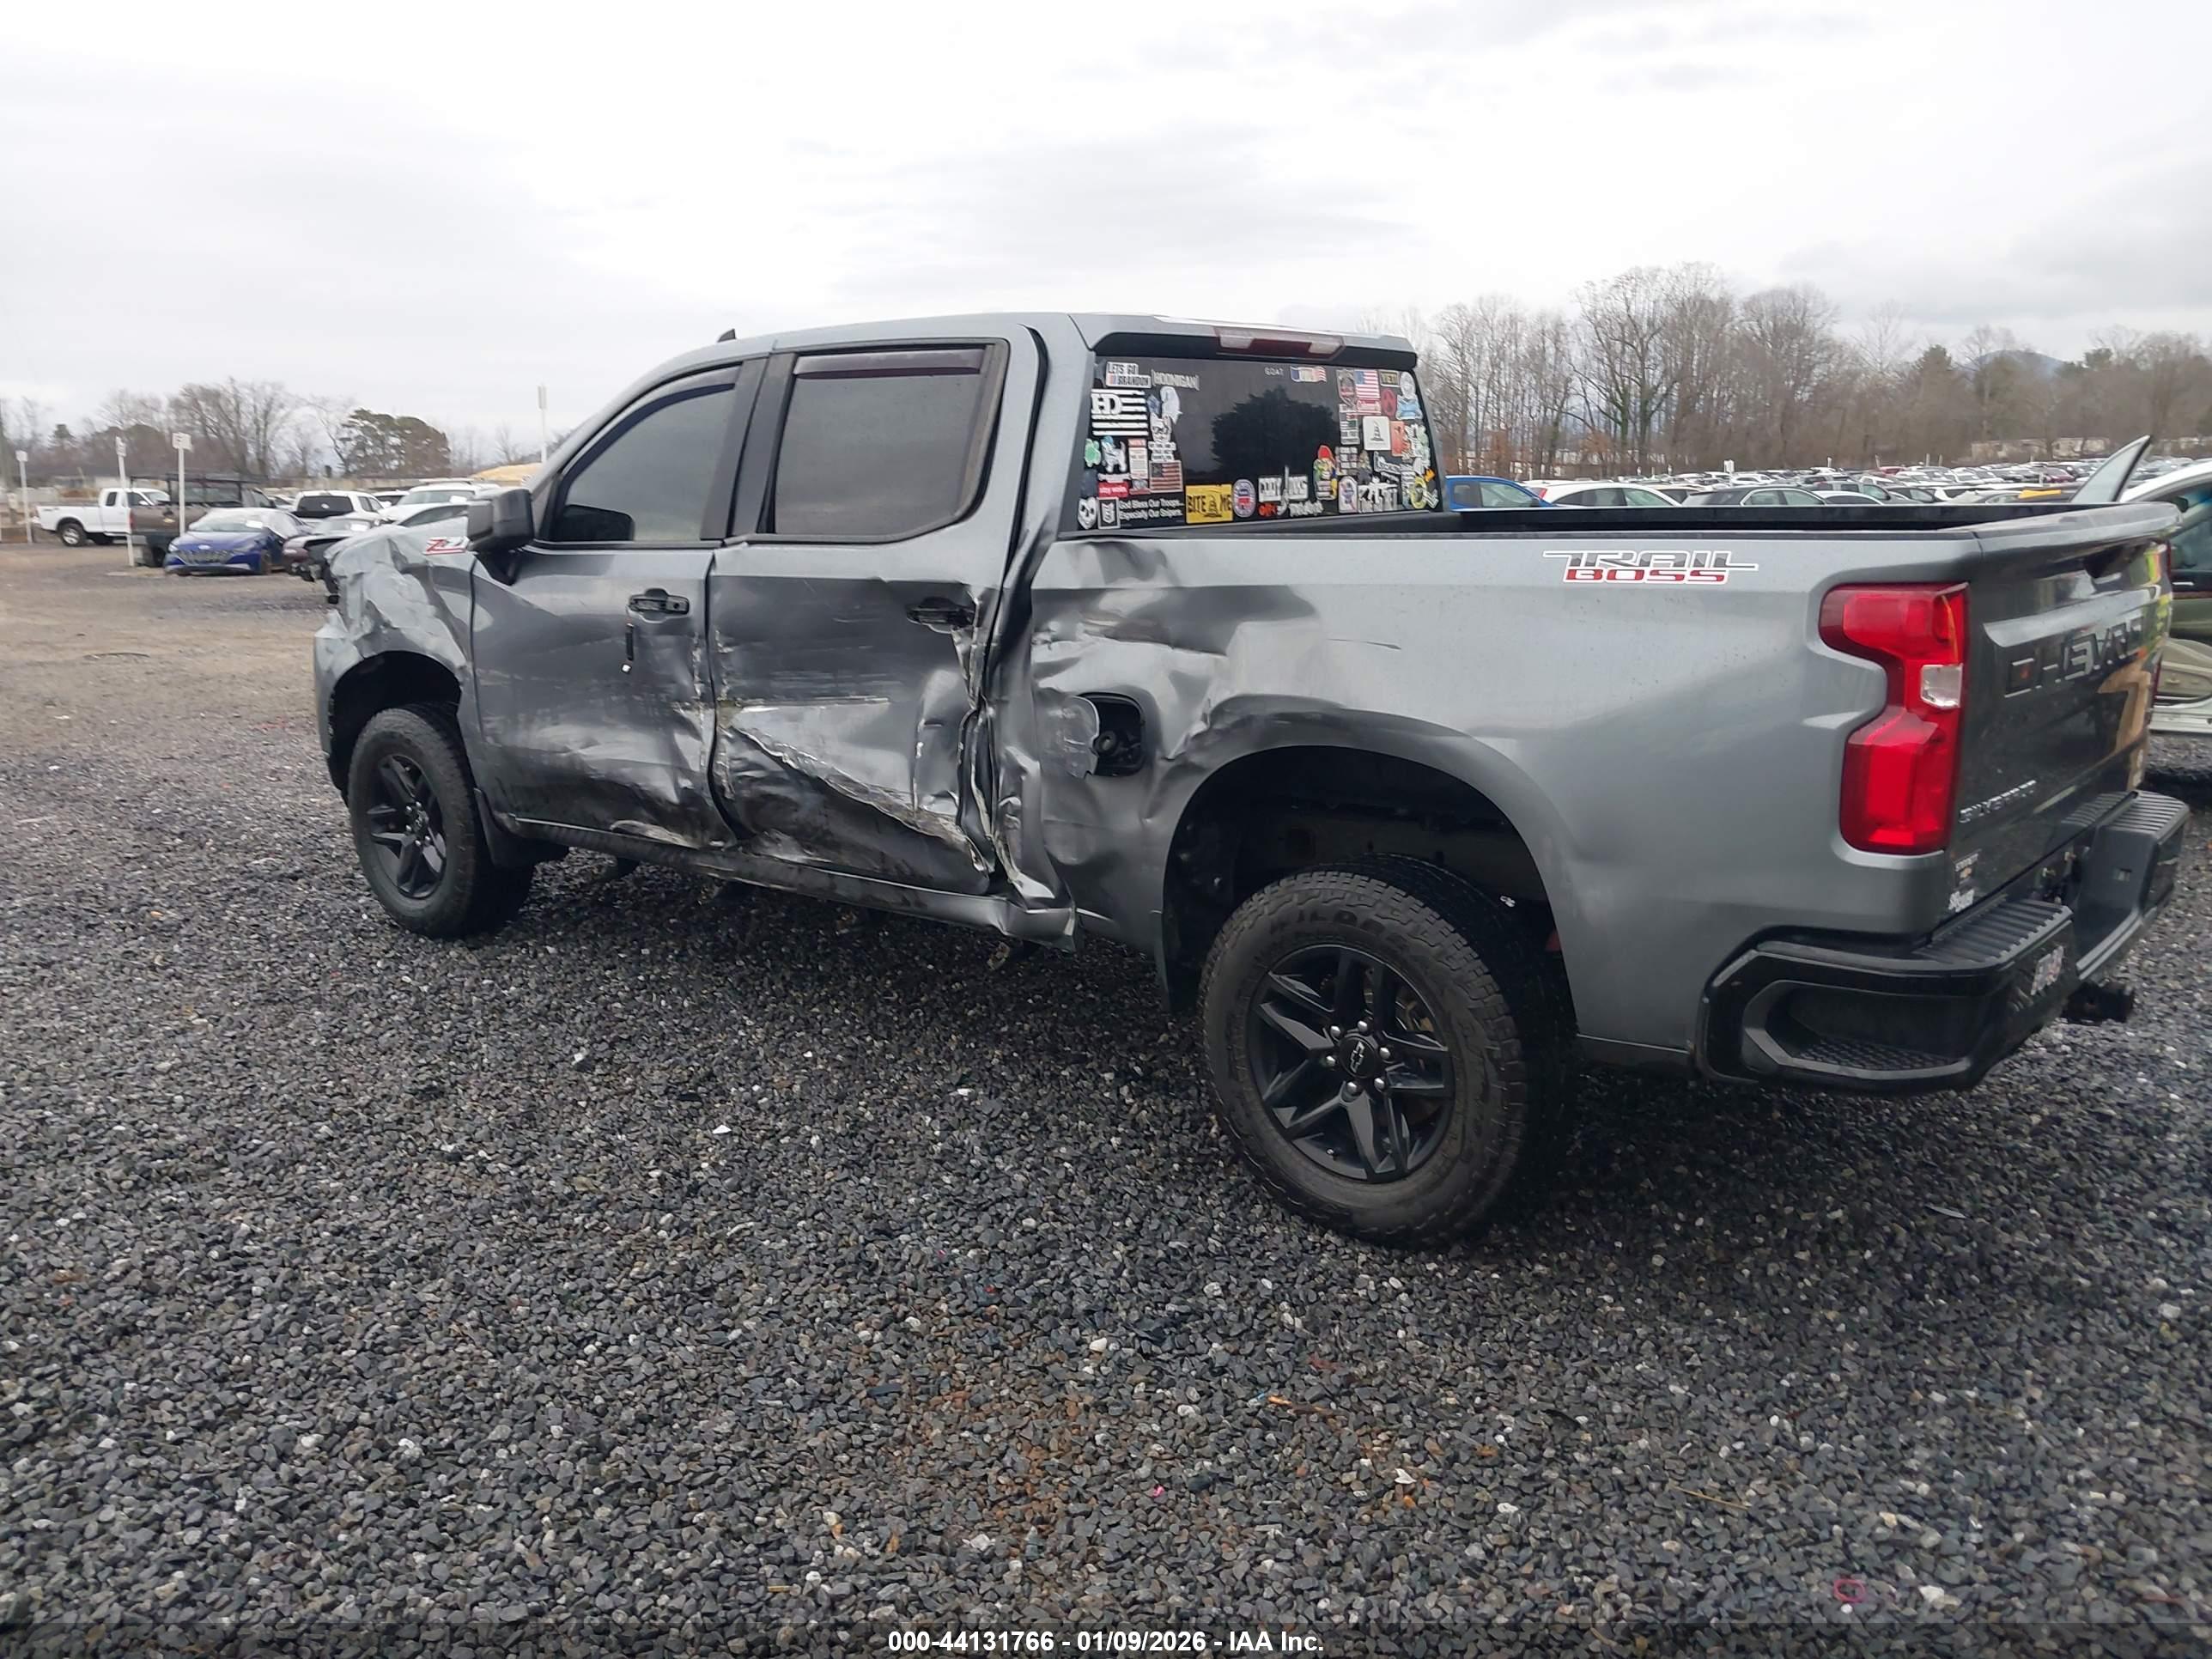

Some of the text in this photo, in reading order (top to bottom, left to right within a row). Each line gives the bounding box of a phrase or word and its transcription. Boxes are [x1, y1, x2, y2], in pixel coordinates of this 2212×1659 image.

[1187, 495, 1206, 514] BITE
[1220, 494, 1231, 512] ME
[1543, 550, 1759, 570] TRAIL
[1564, 568, 1727, 584] BOSS
